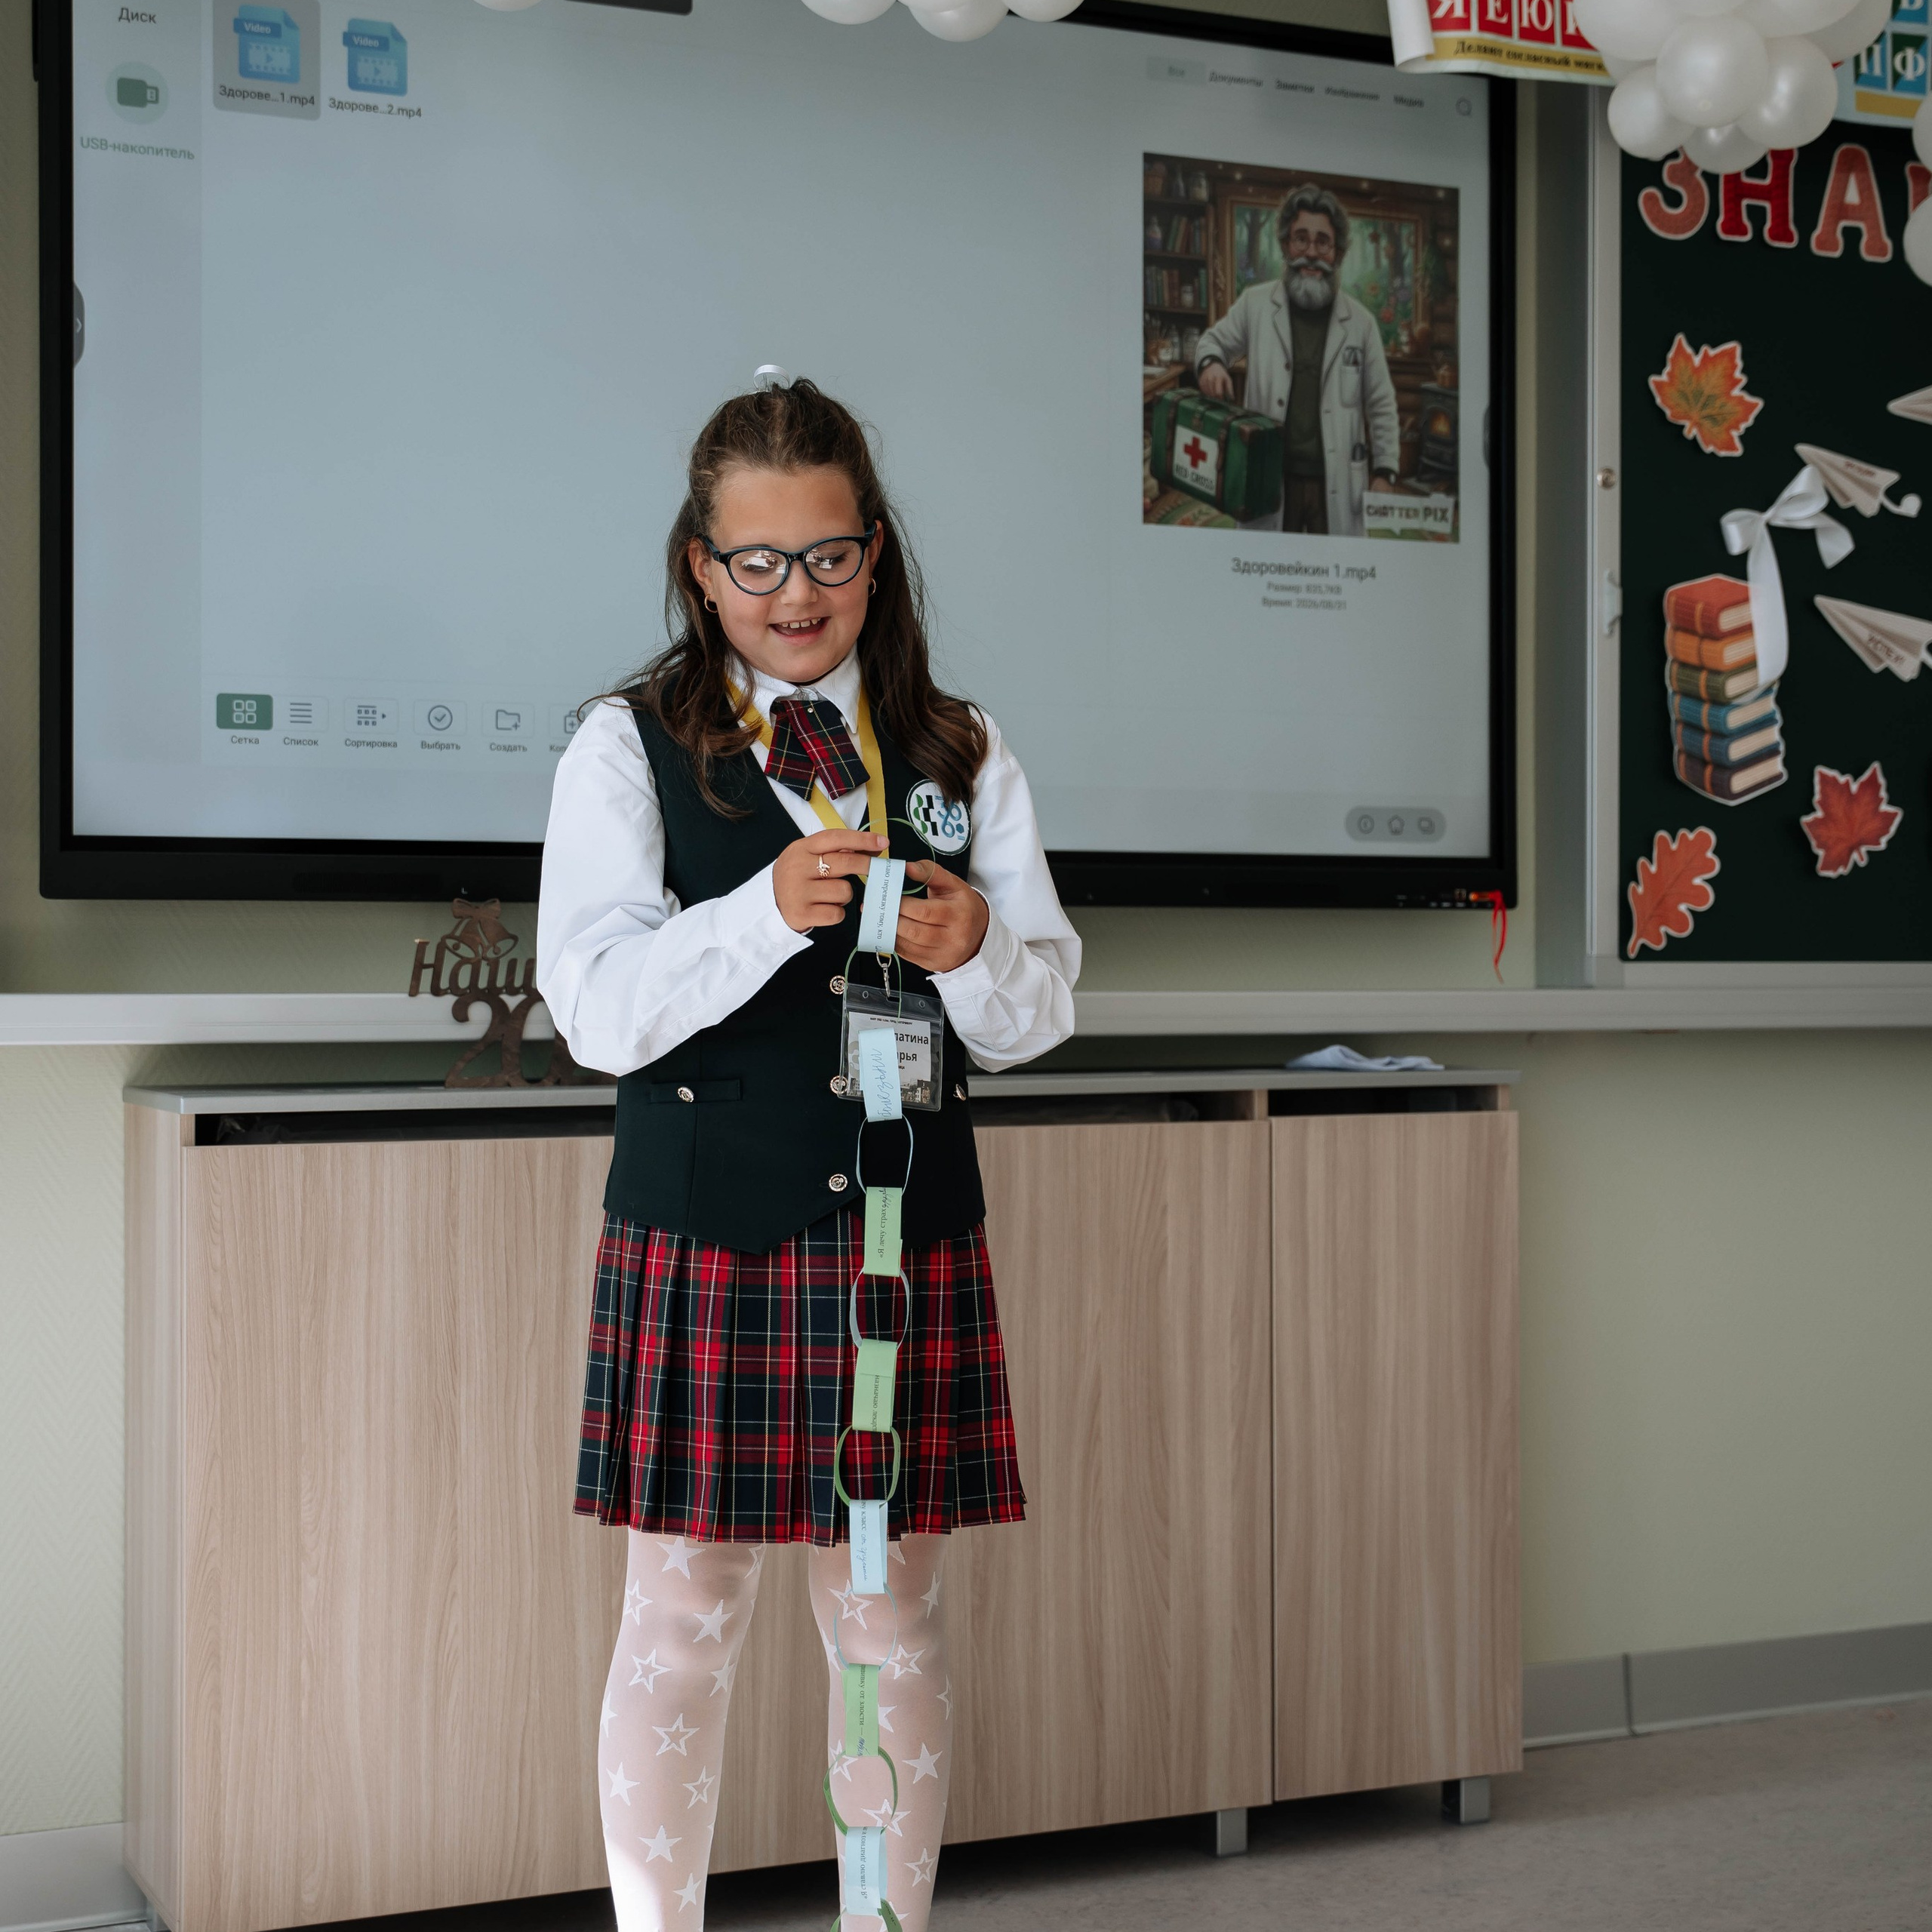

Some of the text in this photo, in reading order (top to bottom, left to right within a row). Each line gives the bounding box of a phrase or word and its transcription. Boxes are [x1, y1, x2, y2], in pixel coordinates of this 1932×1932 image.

[118, 7, 157, 25] Диск
[243, 22, 272, 35] Video
[352, 35, 380, 48] Video
[79, 136, 195, 161] USB-накопитель
[1231, 556, 1377, 584] Здоровейкин 1.mp4
[230, 735, 260, 746] Сетка
[283, 736, 319, 748] Список
[344, 737, 398, 750] Сортировка
[420, 740, 461, 752] Выбрать
[489, 742, 528, 754] Создать
[879, 879, 891, 910] перевязку
[877, 912, 886, 928] тому,
[897, 1051, 918, 1063] рья
[880, 1208, 888, 1228] страх
[879, 1230, 888, 1247] лечу
[872, 1374, 881, 1408] назначаю
